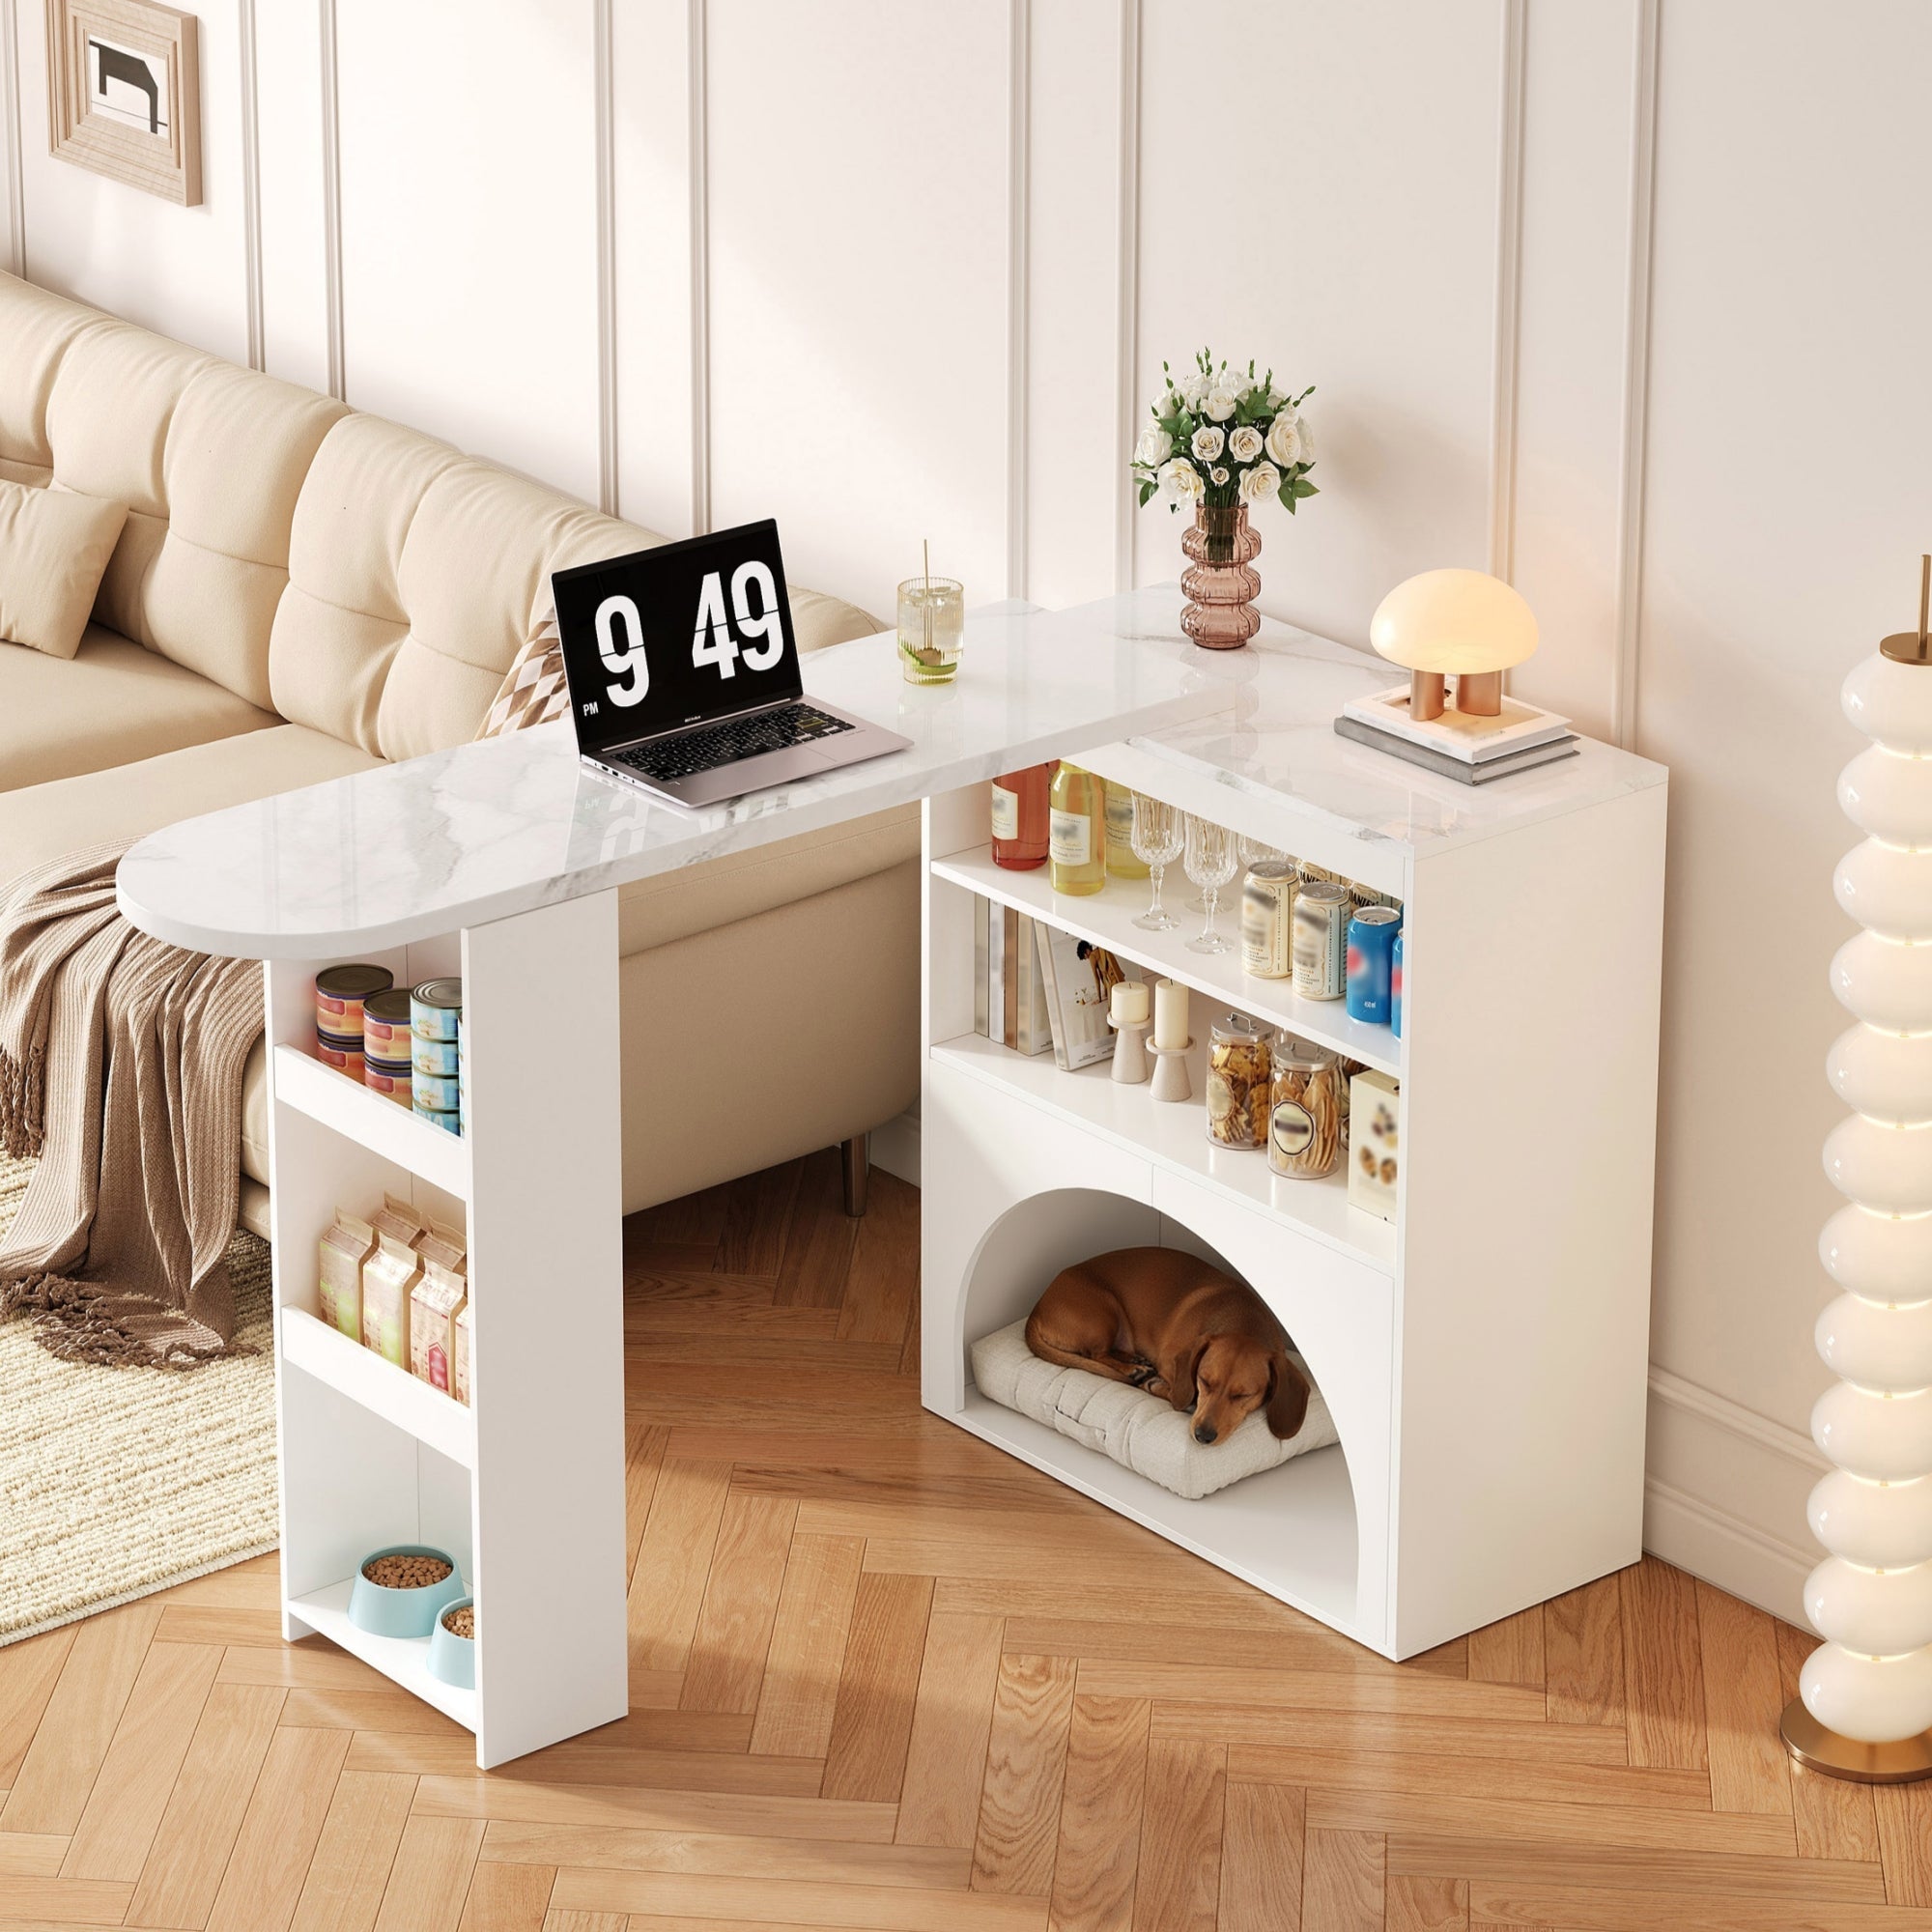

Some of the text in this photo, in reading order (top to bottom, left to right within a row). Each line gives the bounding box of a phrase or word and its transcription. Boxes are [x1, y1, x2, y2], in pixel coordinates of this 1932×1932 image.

[594, 560, 784, 707] 9 49
[582, 701, 599, 717] PM
